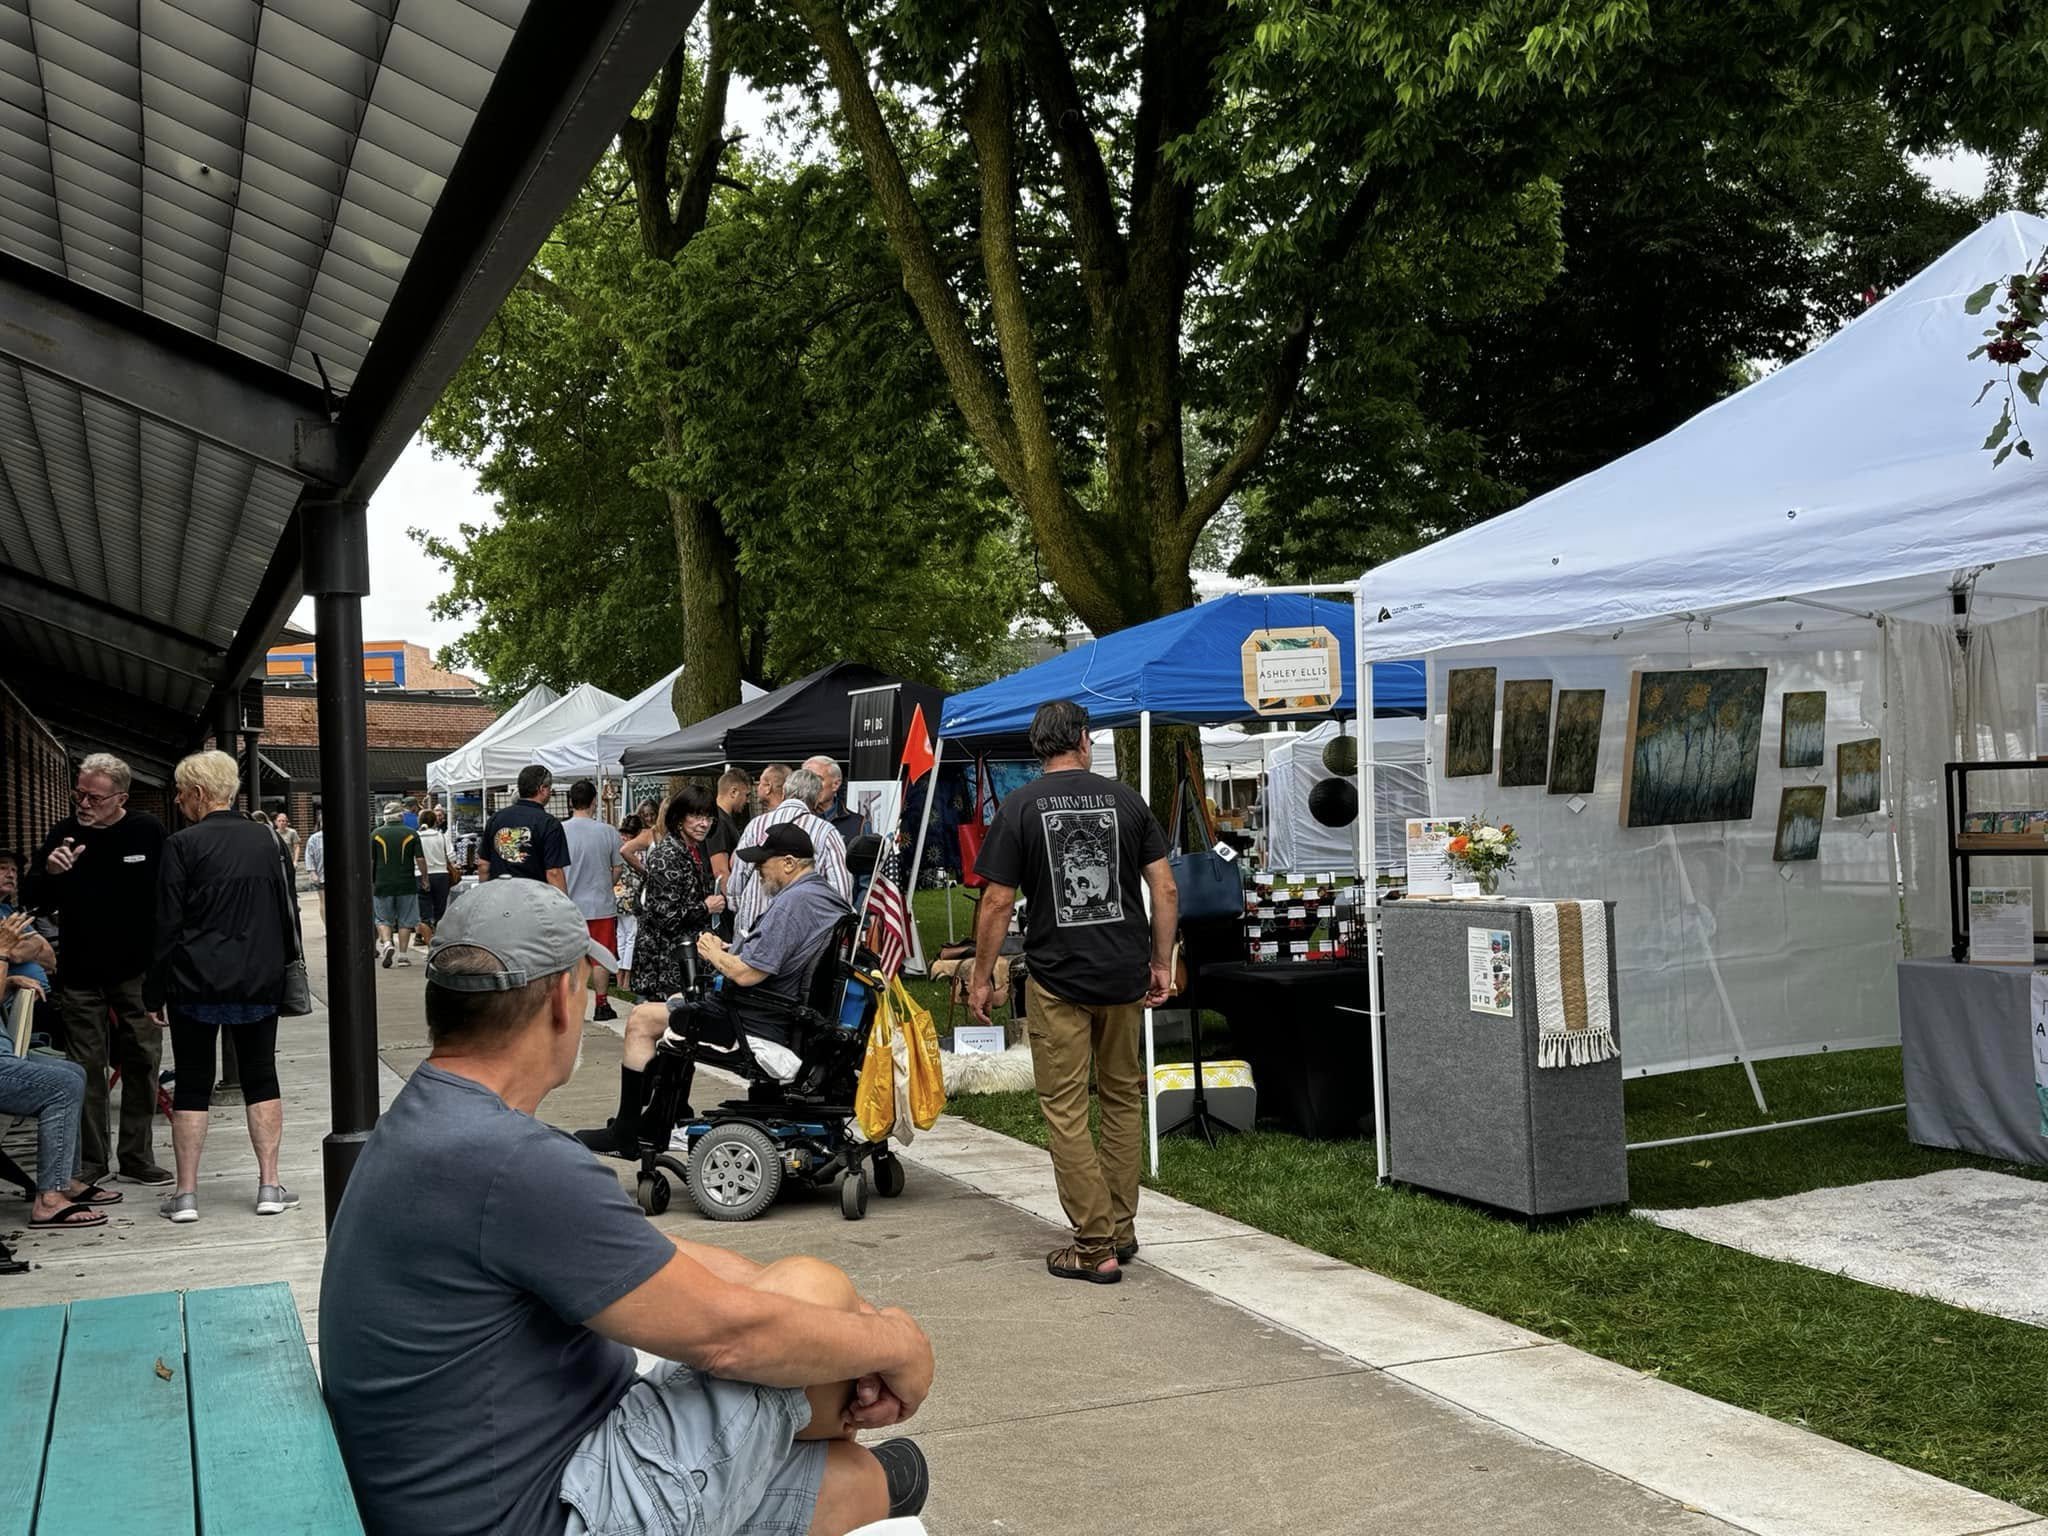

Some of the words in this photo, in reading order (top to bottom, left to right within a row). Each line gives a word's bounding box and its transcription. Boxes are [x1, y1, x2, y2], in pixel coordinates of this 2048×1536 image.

[1259, 669, 1297, 679] ASHLEY
[1301, 667, 1327, 677] ELLIS
[1049, 794, 1105, 809] AIRWALK
